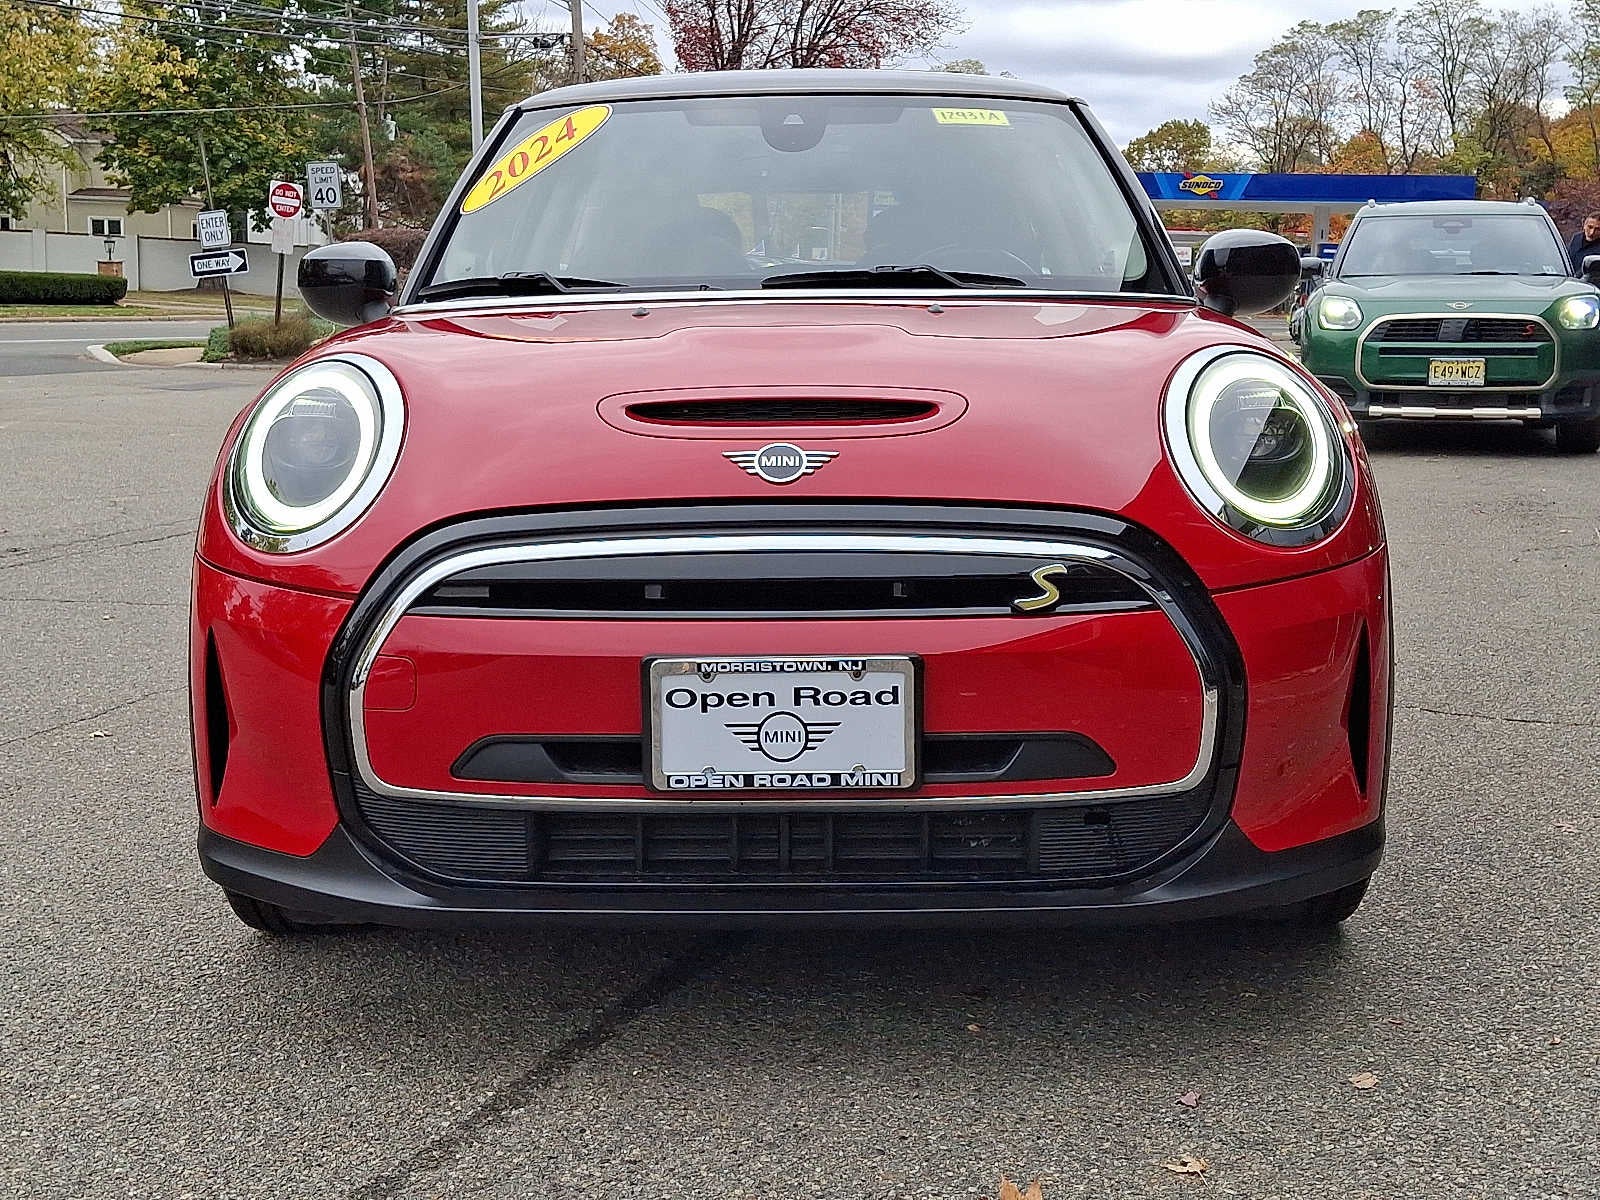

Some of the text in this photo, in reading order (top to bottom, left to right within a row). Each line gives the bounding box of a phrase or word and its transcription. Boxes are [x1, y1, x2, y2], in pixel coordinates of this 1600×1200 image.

[485, 116, 577, 201] 2024
[311, 166, 335, 175] SPEED
[314, 176, 333, 184] LIMIT
[1181, 181, 1222, 189] SUNOCO
[275, 188, 298, 199] DO NOT
[314, 187, 337, 204] 40
[275, 204, 295, 213] ENTER
[200, 216, 225, 229] ENTER
[204, 230, 224, 243] ONLY
[196, 257, 231, 270] ONE WAY
[1522, 324, 1535, 336] S
[761, 455, 800, 467] MINI
[1014, 563, 1068, 611] S
[838, 661, 863, 671] NJ
[665, 685, 900, 714] Open Road
[764, 730, 802, 744] MINI
[669, 773, 899, 788] OPEN ROAD MINI
